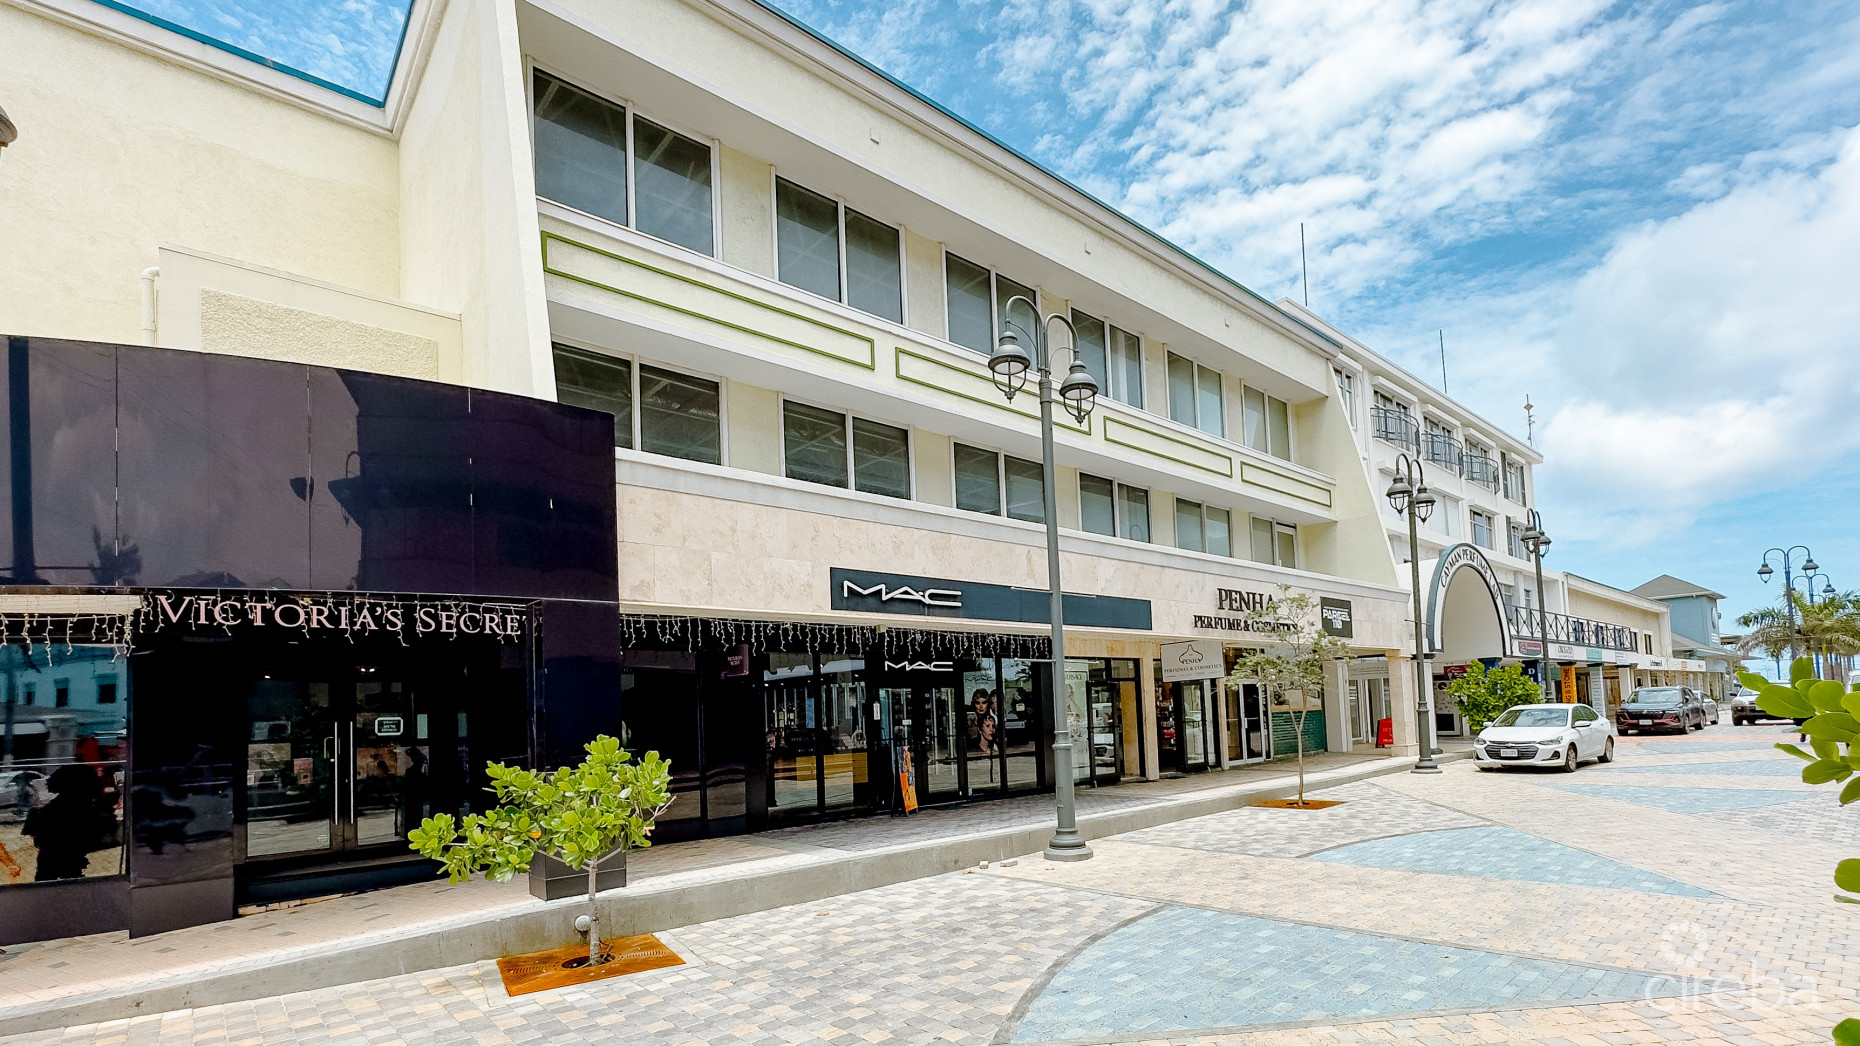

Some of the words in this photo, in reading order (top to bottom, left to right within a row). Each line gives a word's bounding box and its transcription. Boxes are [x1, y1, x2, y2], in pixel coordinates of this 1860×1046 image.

[1441, 549, 1462, 588] CAYMAN
[1462, 549, 1487, 579] PERFUME
[843, 580, 962, 607] MAC
[1216, 588, 1275, 612] PENHA
[156, 594, 402, 631] VICTORIA'S
[1193, 614, 1242, 631] PERFUME
[1243, 618, 1251, 631] &
[1322, 608, 1351, 621] PARCEL
[884, 660, 954, 672] MAC
[1194, 663, 1223, 671] COSMETICS
[1563, 667, 1571, 689] STONE
